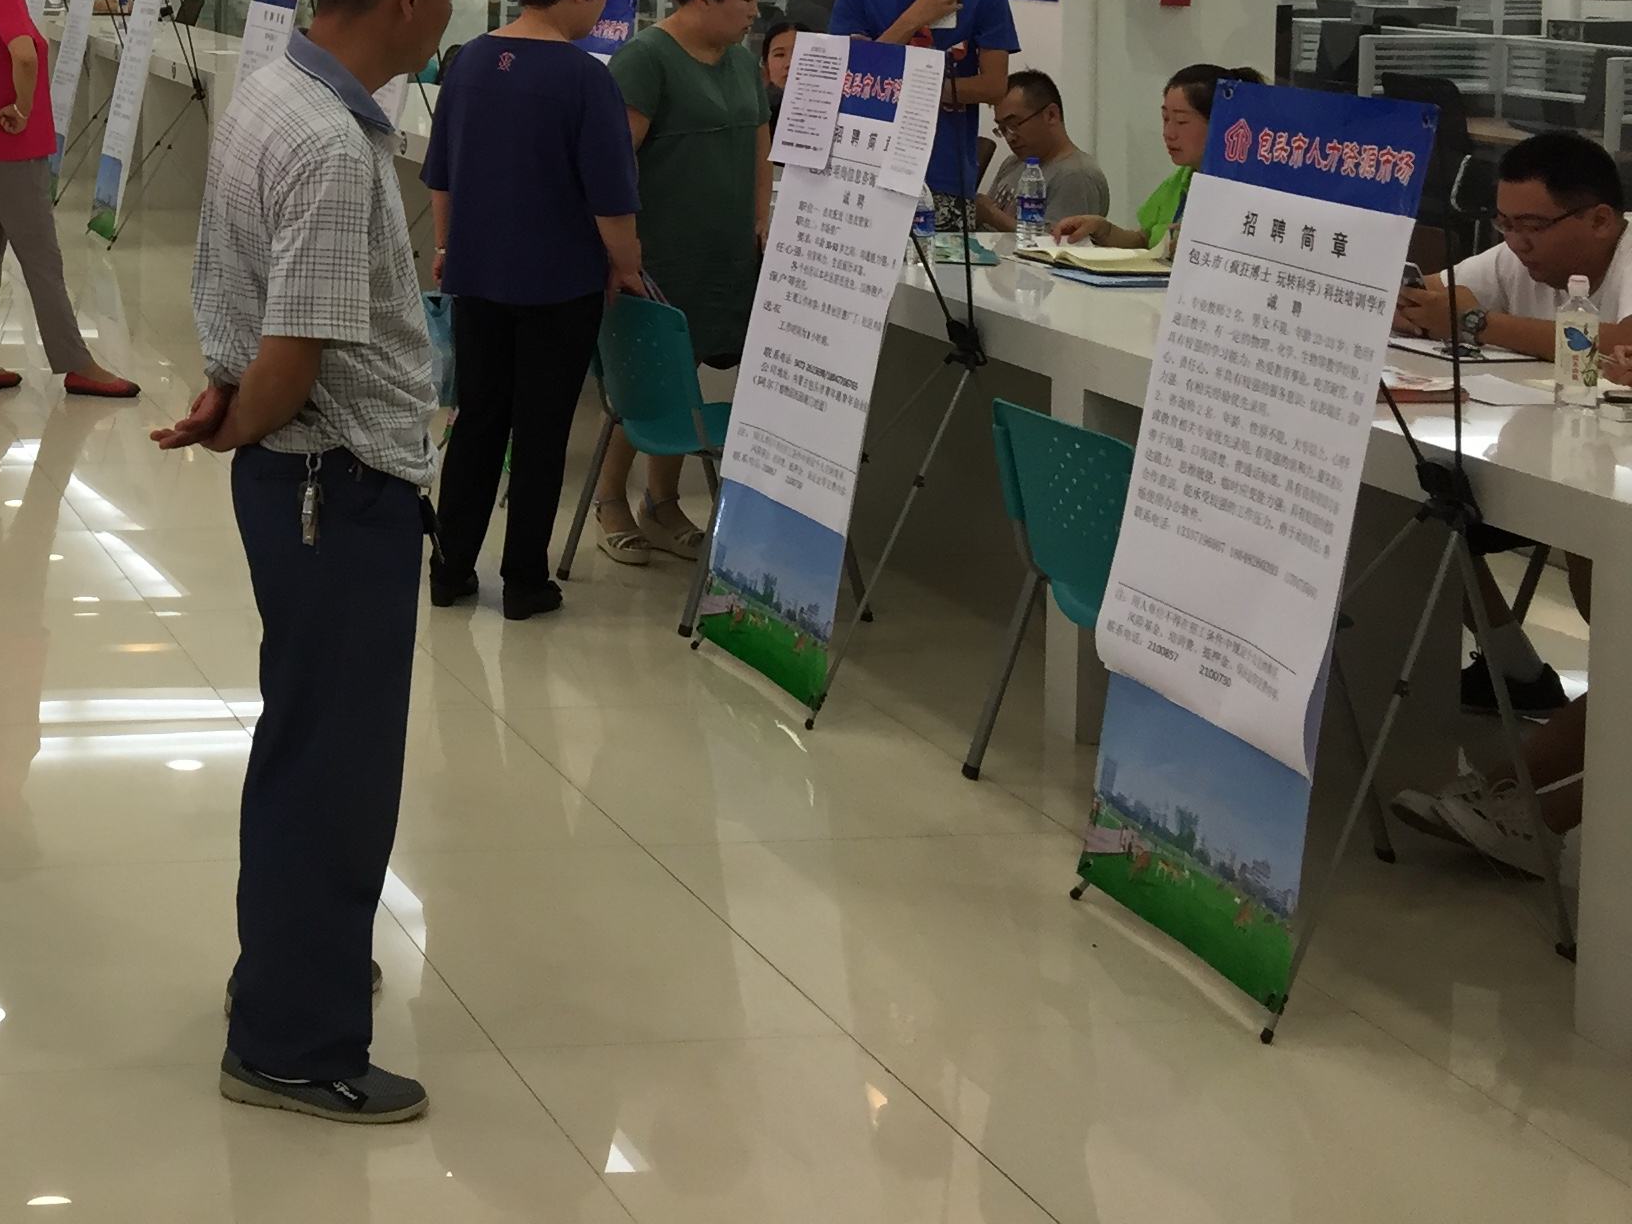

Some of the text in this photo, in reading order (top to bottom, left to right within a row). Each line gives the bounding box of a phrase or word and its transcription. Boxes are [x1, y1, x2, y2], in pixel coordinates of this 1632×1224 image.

[1258, 127, 1415, 186] 包头市人力资源市场
[1242, 210, 1348, 259] 招聘简章
